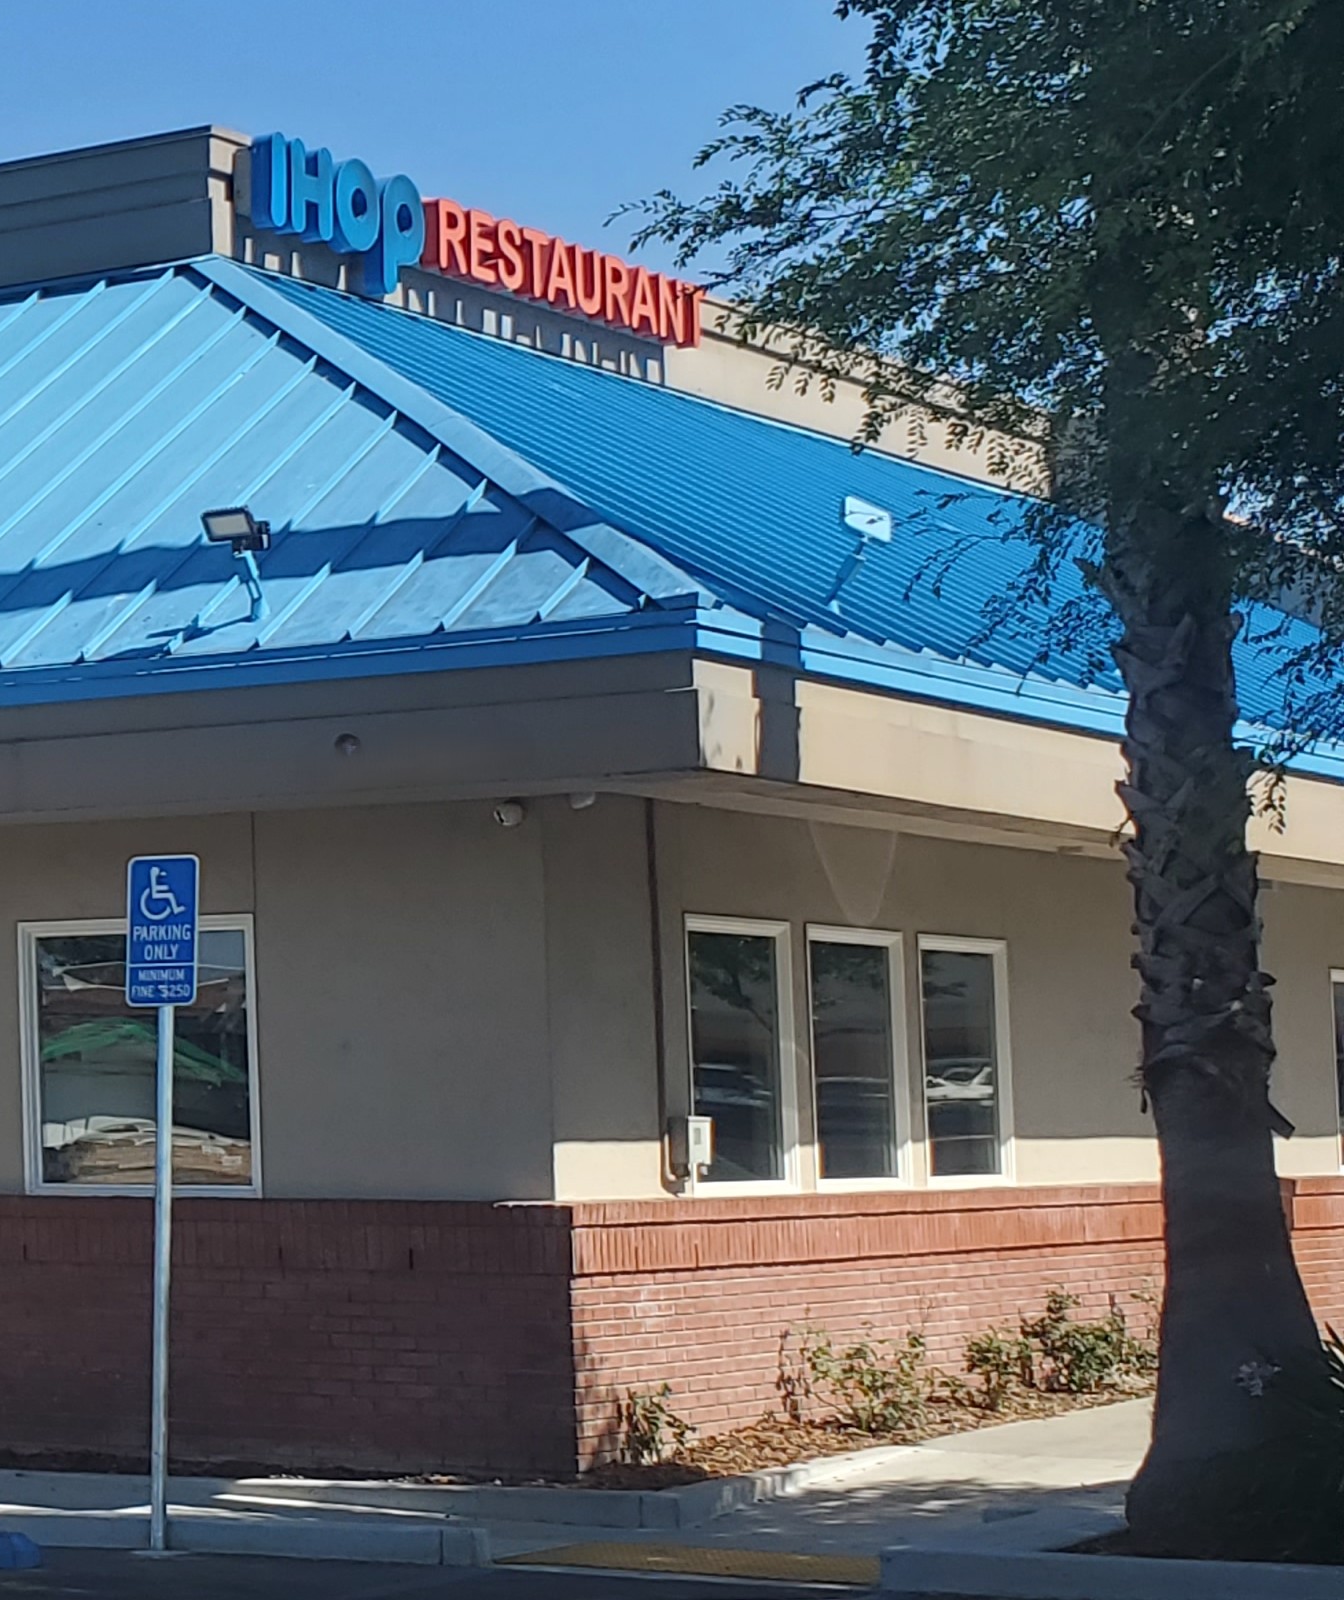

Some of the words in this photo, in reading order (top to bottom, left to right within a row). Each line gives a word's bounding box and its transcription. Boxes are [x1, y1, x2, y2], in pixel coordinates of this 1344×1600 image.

[251, 131, 425, 295] IHOP
[422, 197, 706, 349] RESTAURANT
[132, 923, 192, 942] PARKING
[143, 943, 179, 961] ONLY
[138, 969, 185, 981] MINIMUM
[131, 984, 155, 998] FINE
[157, 983, 191, 998] $250
